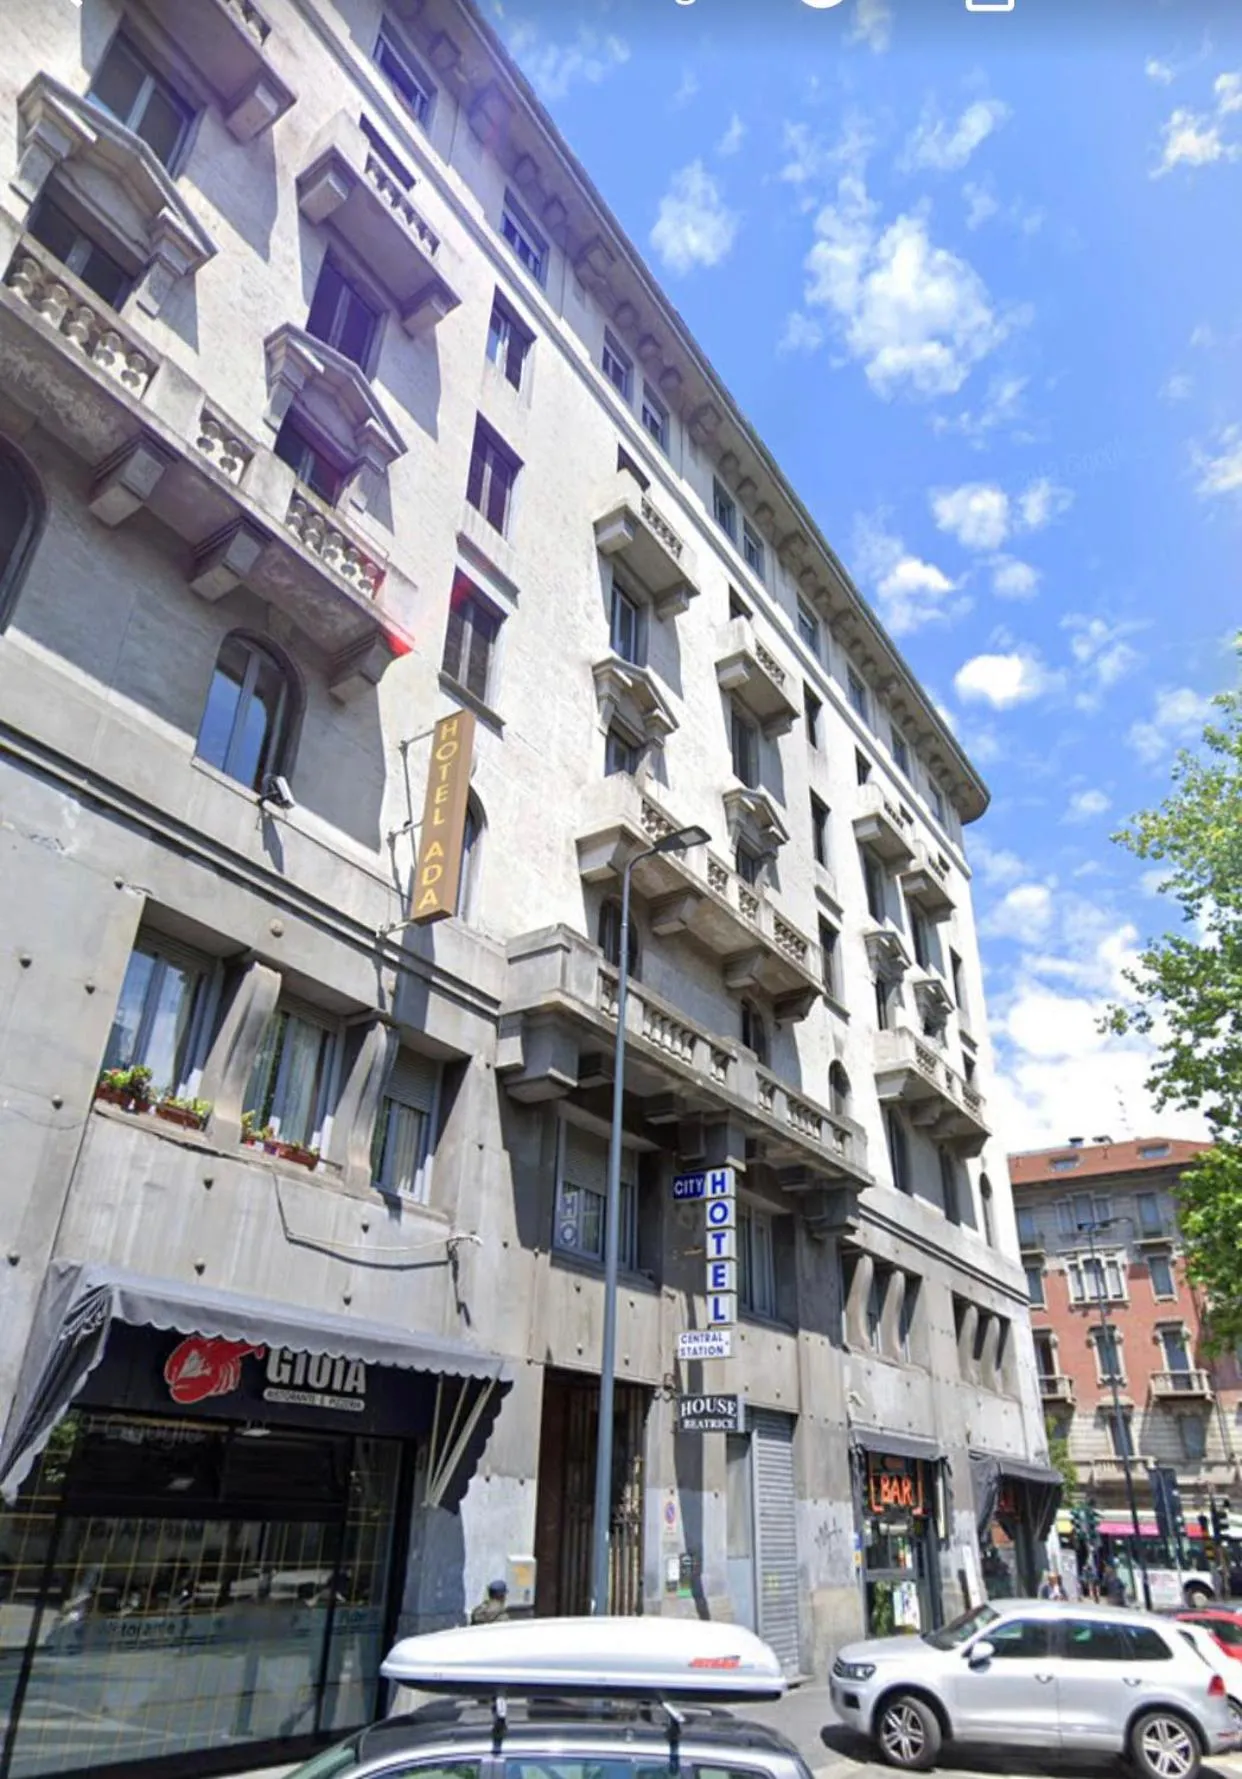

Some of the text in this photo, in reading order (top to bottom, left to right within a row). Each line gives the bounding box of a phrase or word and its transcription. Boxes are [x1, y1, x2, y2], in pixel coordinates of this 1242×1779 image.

[418, 719, 458, 910] HOTEL ADA
[674, 1178, 704, 1196] CITY
[709, 1171, 728, 1320] HOTEL
[681, 1332, 724, 1344] CENTRAL
[680, 1345, 724, 1356] STATION
[681, 1397, 737, 1417] HOUSE
[683, 1418, 735, 1429] BEATRICE
[880, 1474, 913, 1505] BAR
